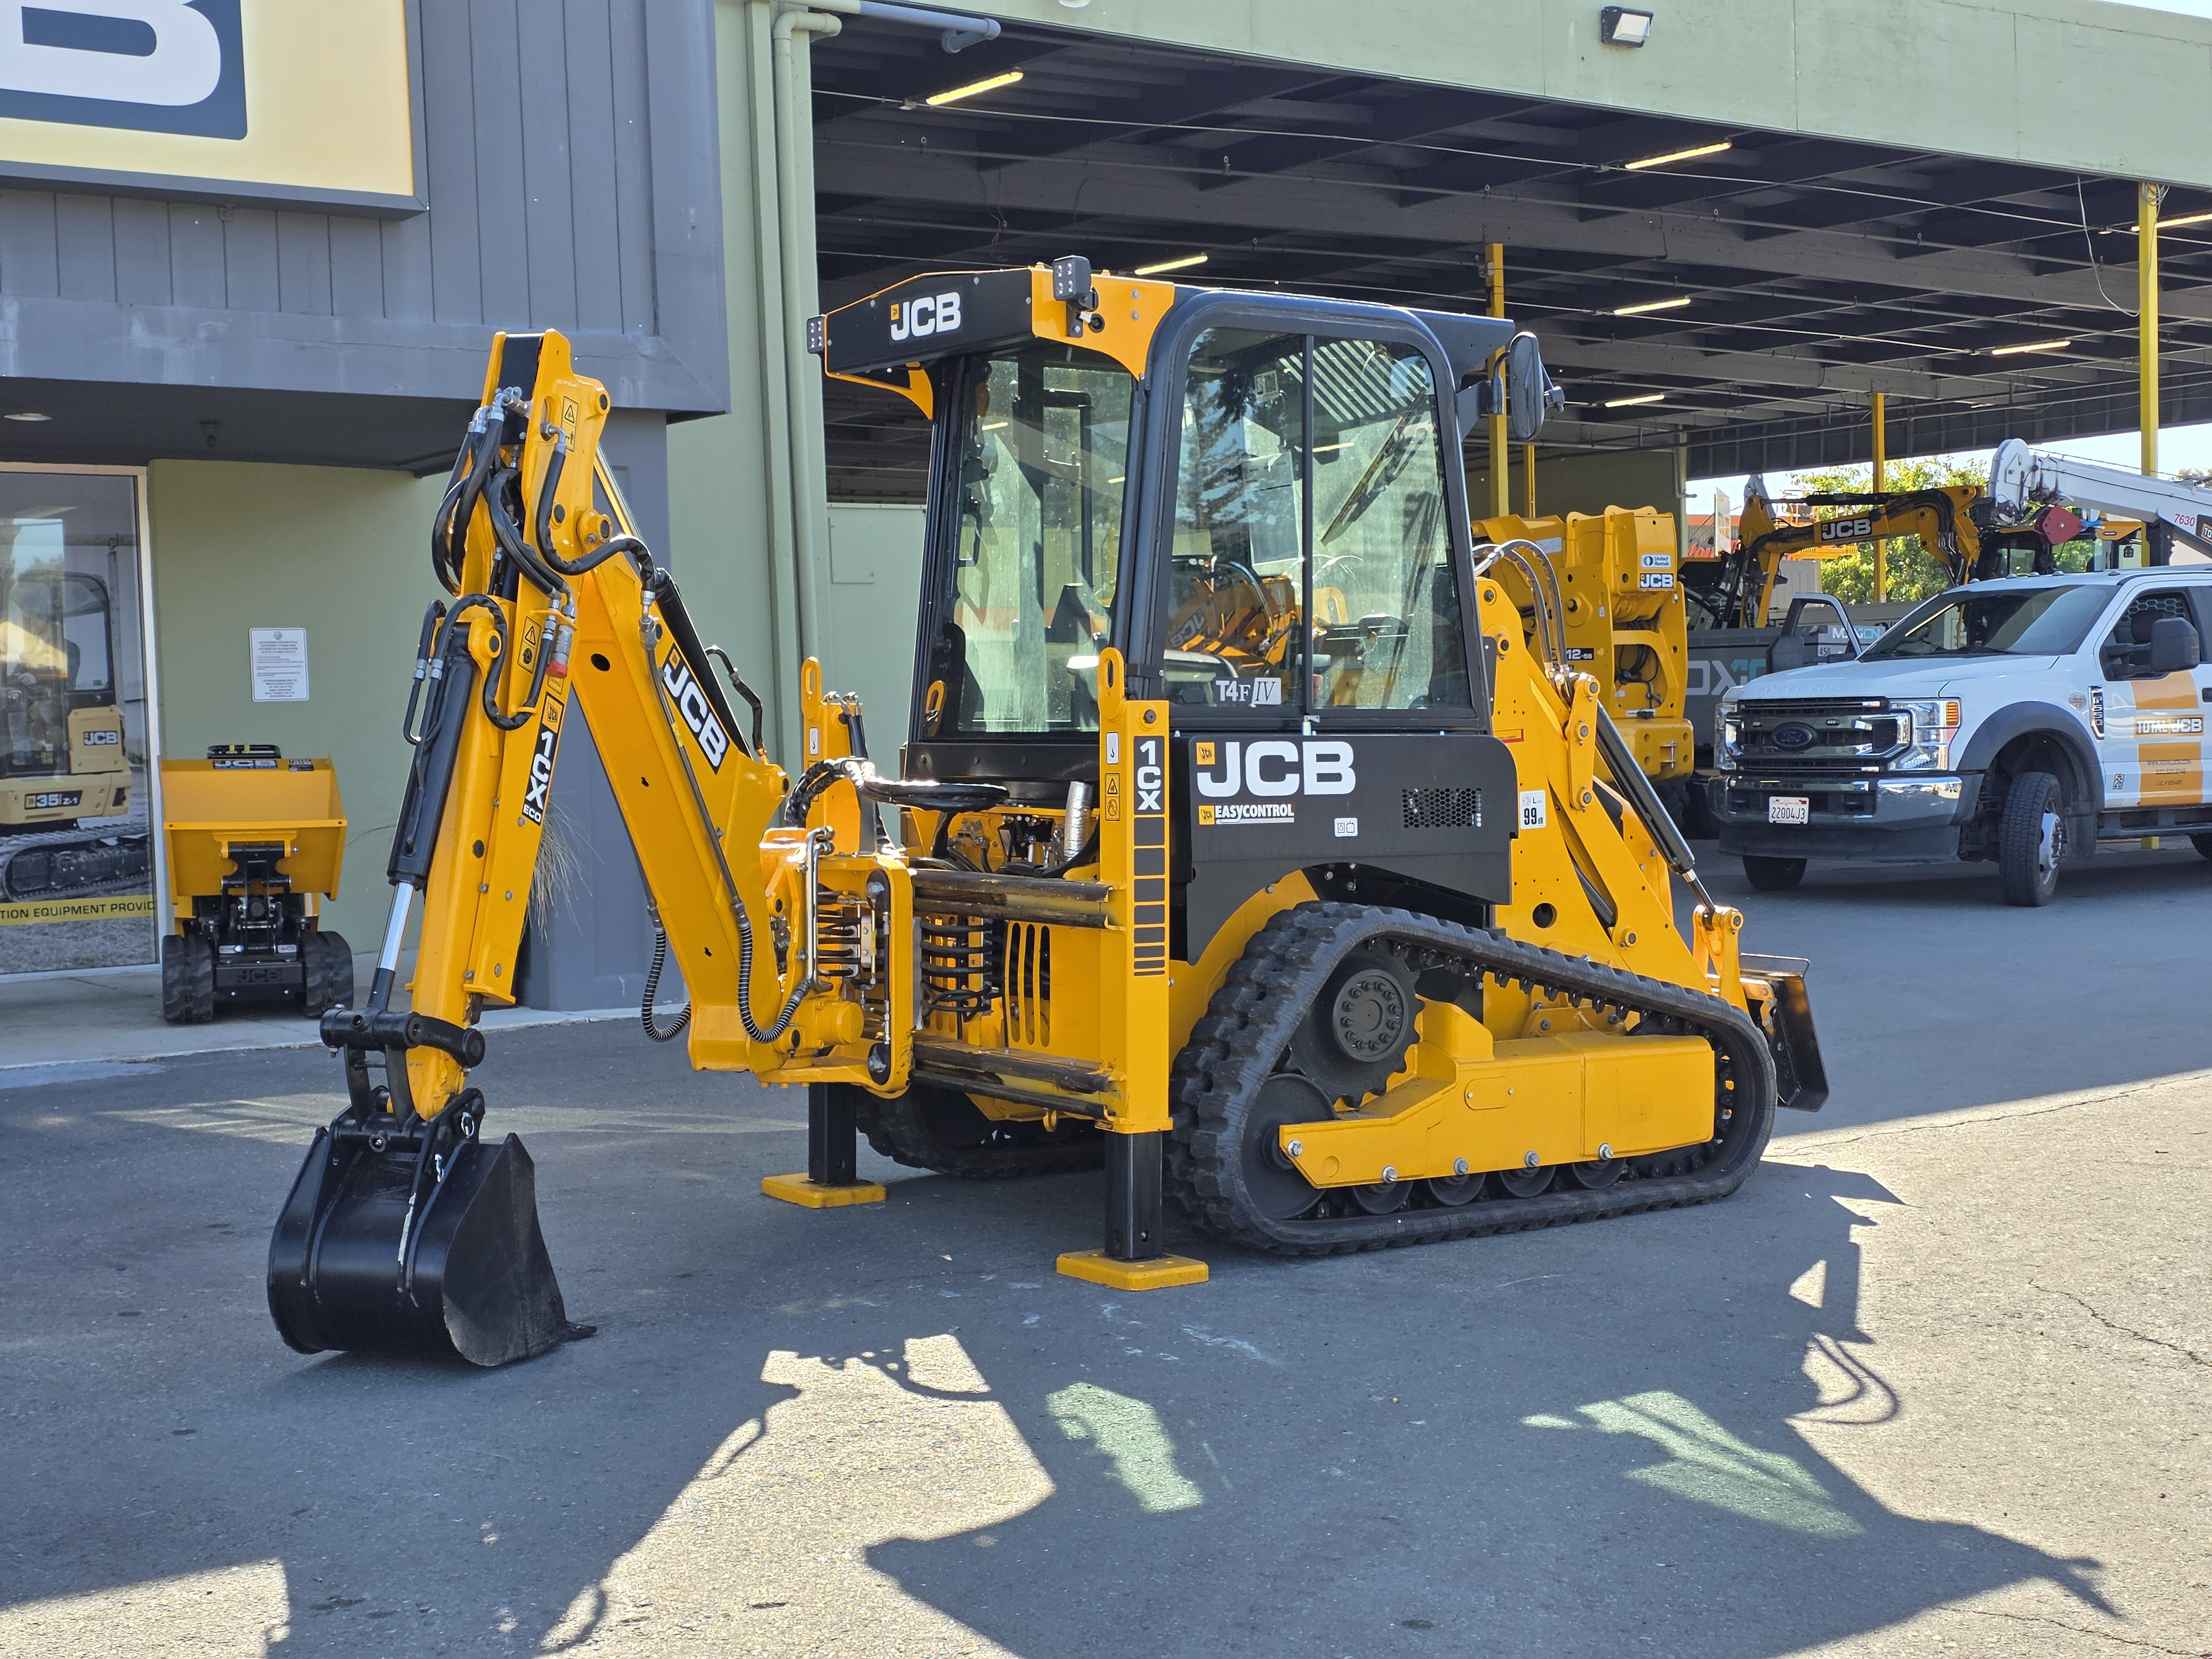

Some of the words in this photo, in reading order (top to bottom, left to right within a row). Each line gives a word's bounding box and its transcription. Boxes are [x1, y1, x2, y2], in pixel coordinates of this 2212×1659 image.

[891, 292, 961, 341] JCB
[2174, 513, 2195, 527] 7630
[1822, 519, 1871, 540] JCB
[1640, 574, 1673, 587] JCB
[664, 662, 726, 767] JCB
[2137, 719, 2168, 733] TOTAL
[2171, 718, 2202, 733] JCB
[84, 732, 118, 745] JCB
[525, 731, 554, 810] 1CX
[1138, 740, 1161, 810] 1CX
[1197, 740, 1356, 797] JCB
[2114, 778, 2123, 789] 26
[36, 794, 60, 807] 35
[523, 804, 541, 823] ECO
[1215, 804, 1295, 823] EASYCONTROL
[1524, 807, 1537, 825] 99
[1771, 807, 1806, 820] 22004J3
[33, 904, 106, 917] EQUIPMENT
[237, 969, 282, 983] JCB
